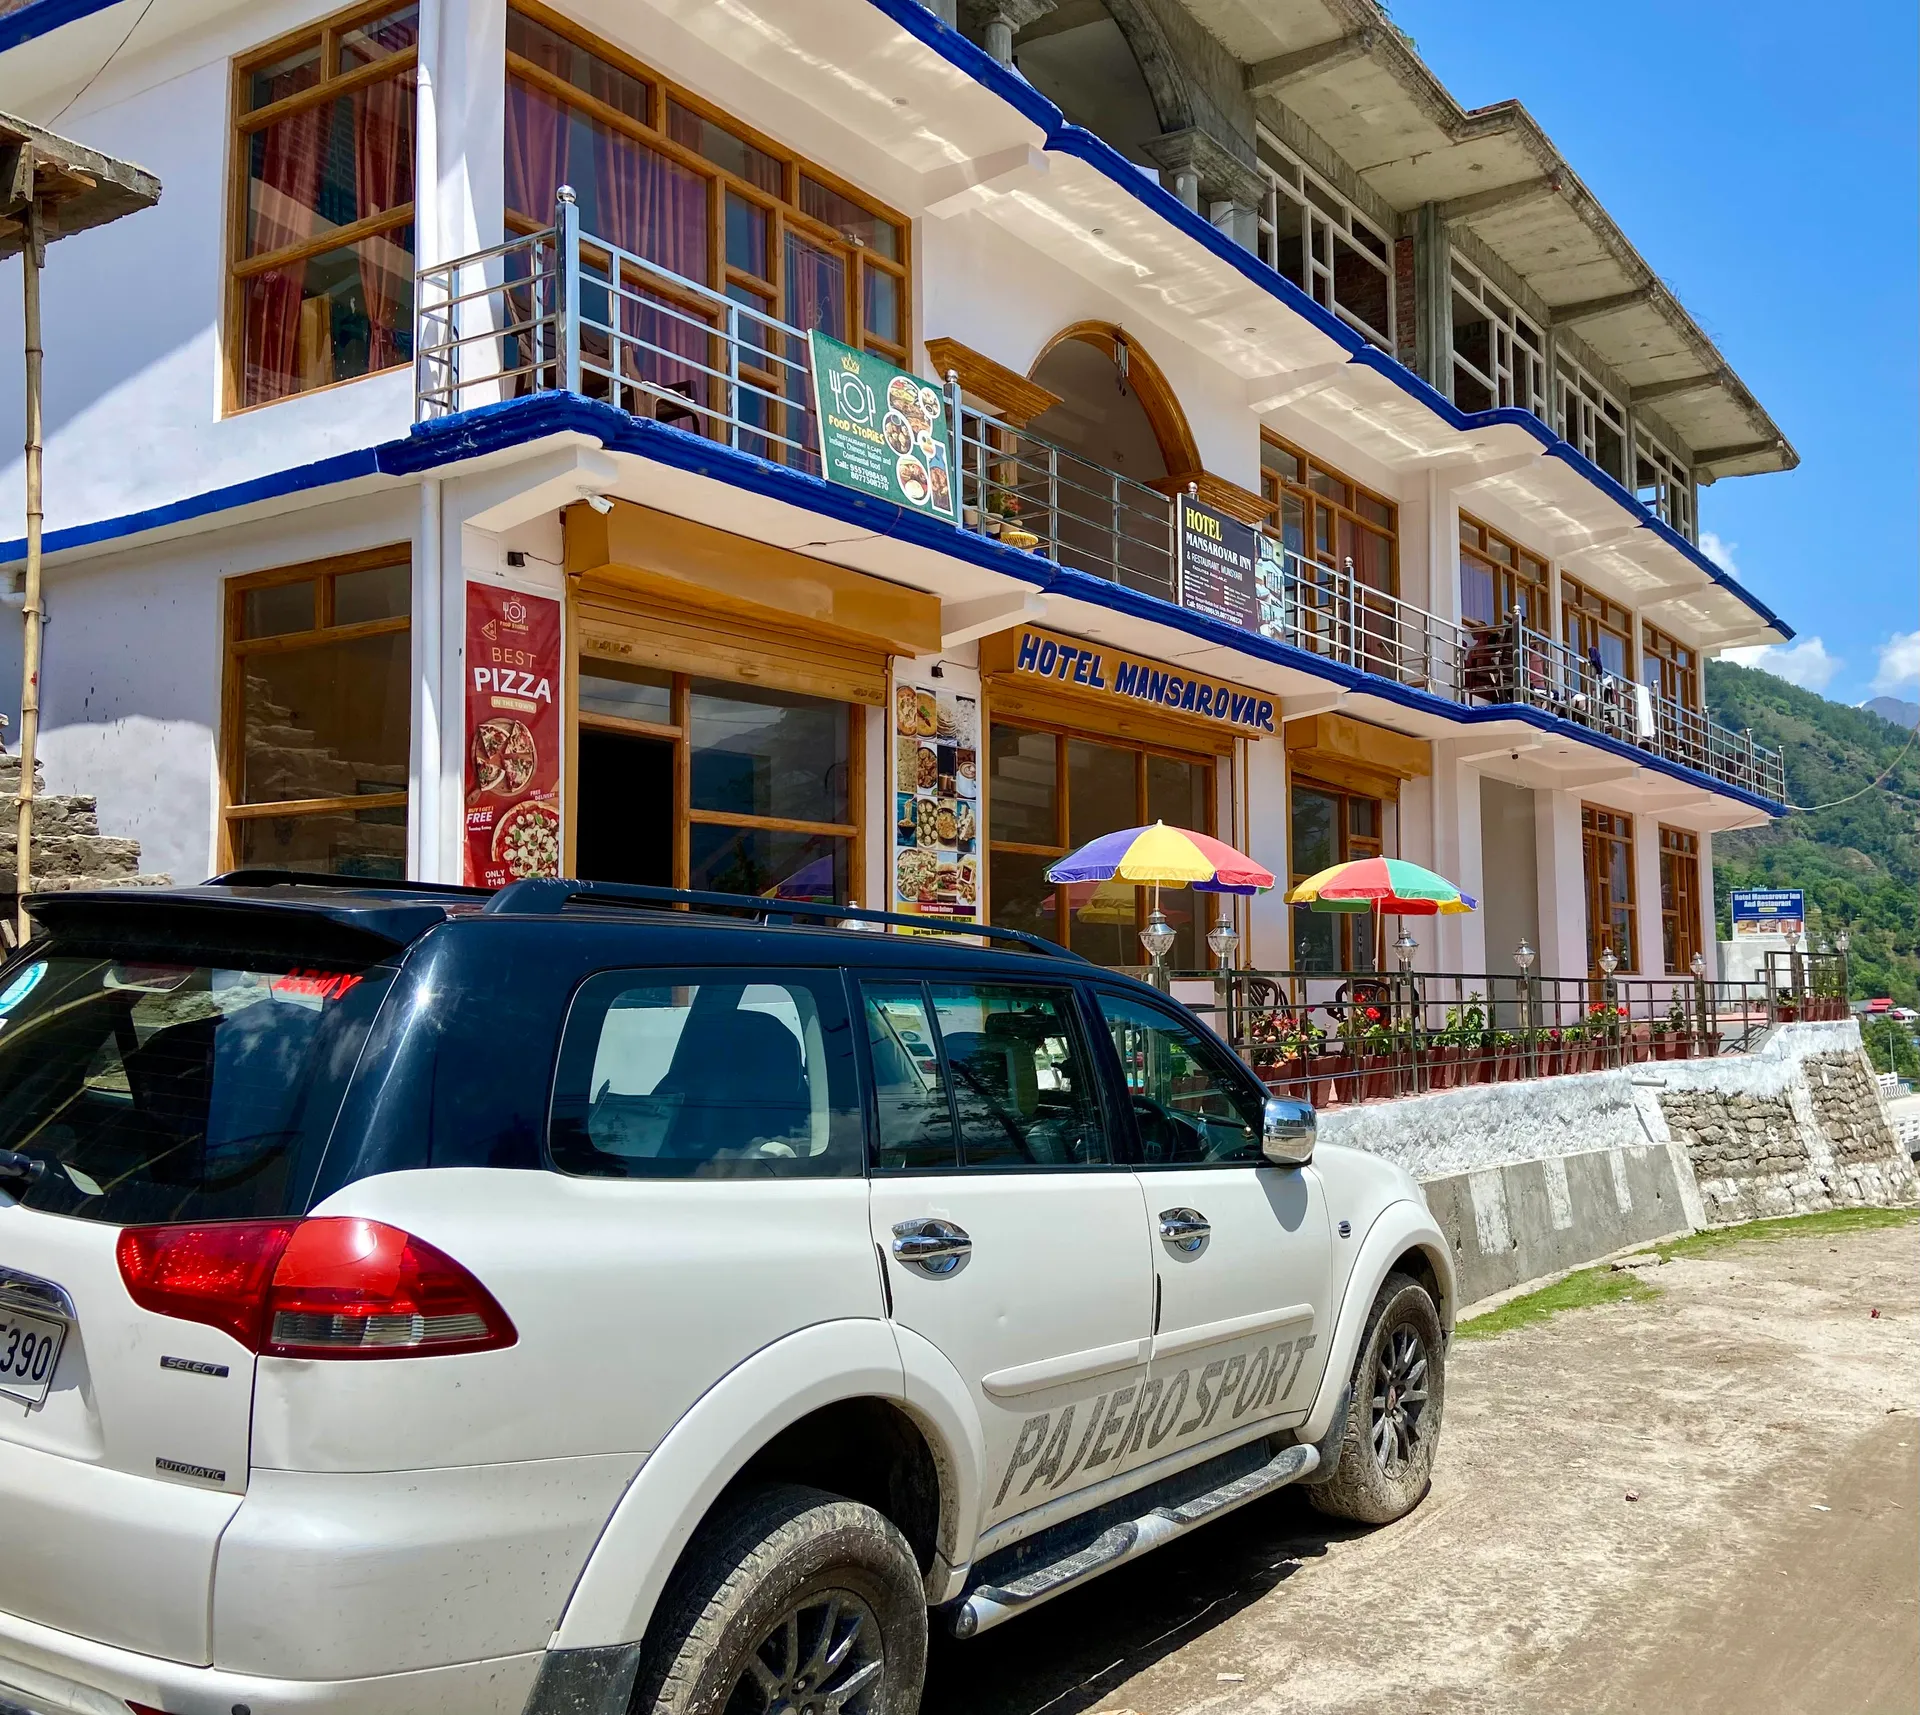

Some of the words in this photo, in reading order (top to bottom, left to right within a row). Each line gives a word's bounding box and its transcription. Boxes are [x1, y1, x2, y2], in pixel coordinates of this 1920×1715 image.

[828, 414, 850, 431] FOOD
[1186, 506, 1222, 542] HOTEL
[1186, 532, 1239, 566] MANSAROVAR
[1240, 554, 1252, 572] INN
[1187, 550, 1191, 560] &
[492, 646, 536, 668] BEST
[474, 667, 552, 704] PIZZA
[1018, 632, 1104, 690] HOTEL
[1114, 660, 1275, 733] MANSAROVAR
[515, 702, 534, 711] TOWN
[535, 792, 555, 800] DELIVERY
[466, 812, 492, 824] FREE
[485, 870, 505, 879] ONLY
[272, 967, 363, 1000] ARMY
[166, 1358, 222, 1376] SELECT
[992, 1368, 1190, 1510] PAJERO
[1176, 1334, 1318, 1438] SPORT
[156, 1459, 224, 1480] AUTOMATIC
